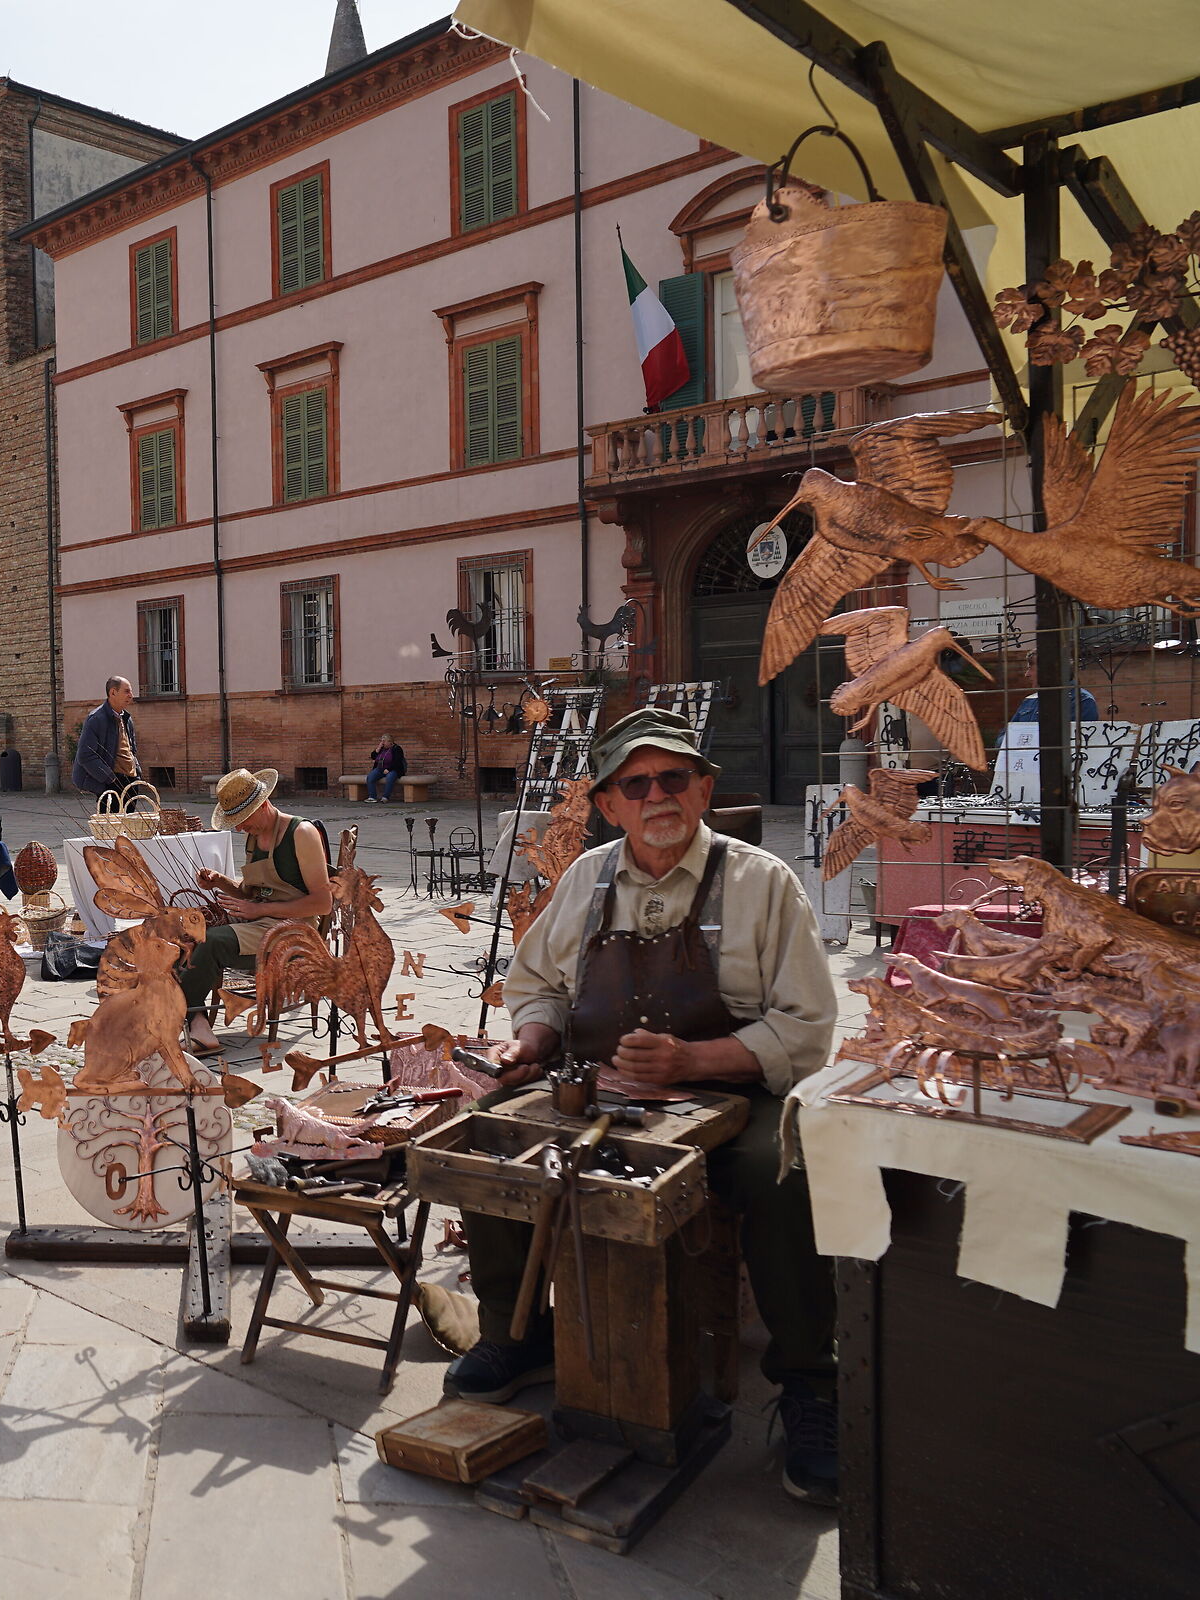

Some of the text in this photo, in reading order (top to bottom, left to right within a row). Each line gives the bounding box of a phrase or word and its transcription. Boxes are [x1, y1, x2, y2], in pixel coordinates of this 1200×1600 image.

[400, 950, 427, 980] N
[394, 992, 416, 1022] E
[258, 1041, 283, 1074] E
